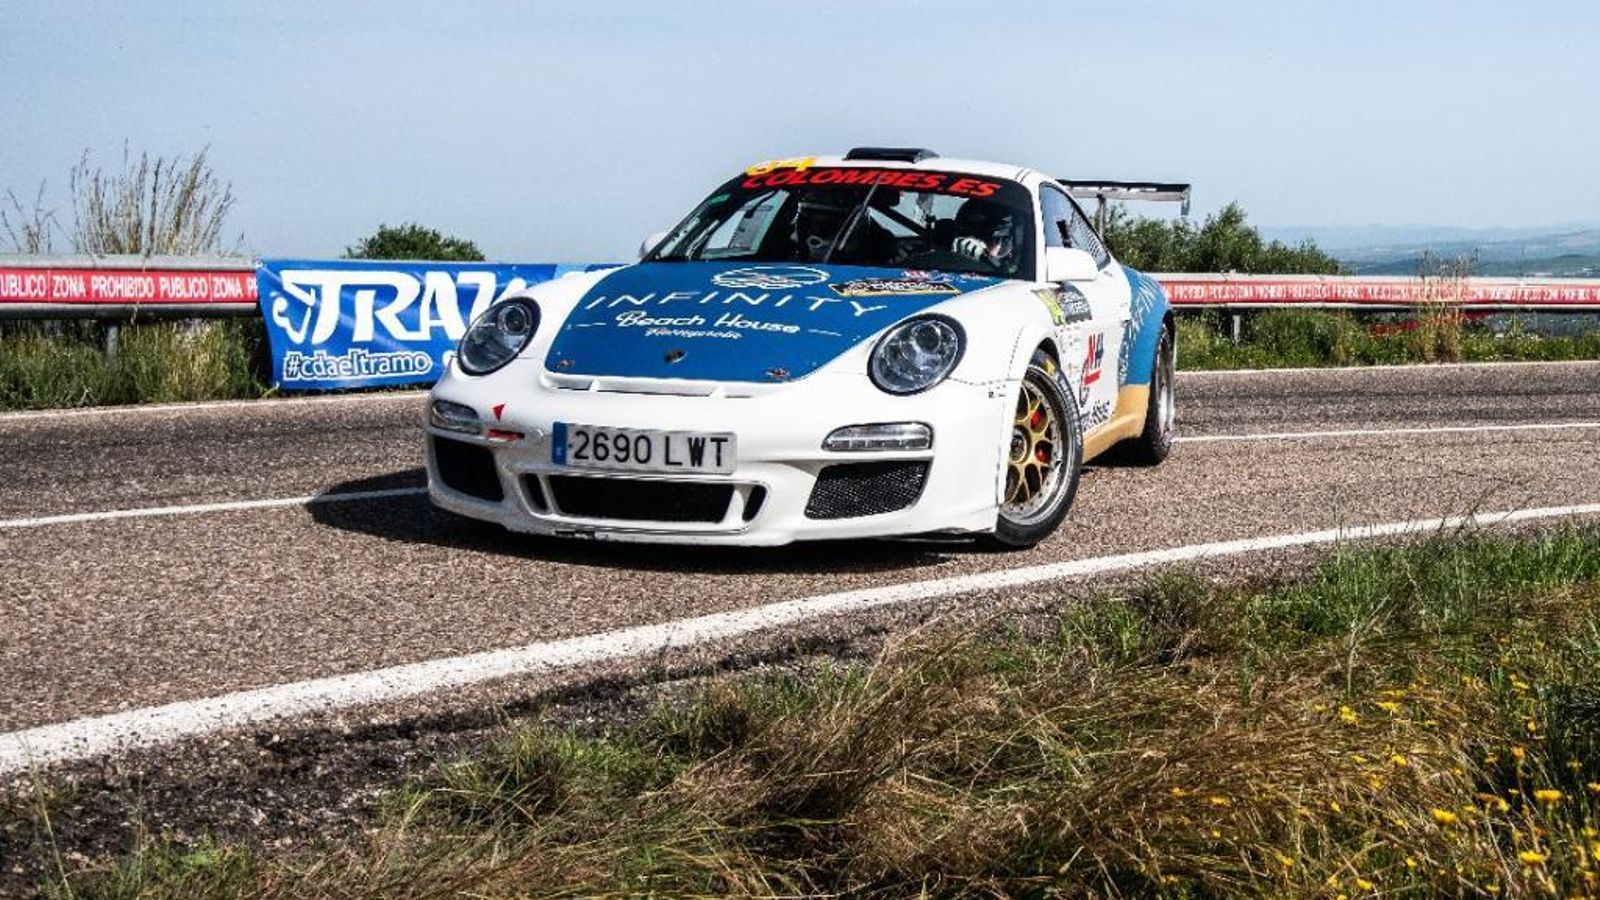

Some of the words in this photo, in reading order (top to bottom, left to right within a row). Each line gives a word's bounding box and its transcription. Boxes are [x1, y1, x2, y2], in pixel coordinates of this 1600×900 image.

[741, 168, 1003, 198] COLOMBES.ES
[0, 273, 46, 297] UBLICO
[52, 275, 86, 298] ZONA
[91, 275, 154, 298] PROHIBIDO
[159, 277, 209, 299] PUBLICO
[213, 278, 242, 299] ZONA
[585, 291, 888, 317] INFINITY
[615, 310, 706, 328] Beach
[713, 312, 801, 334] House
[285, 351, 431, 379] #cdaeltramo
[573, 430, 652, 465] 2690
[664, 435, 729, 468] LWT
